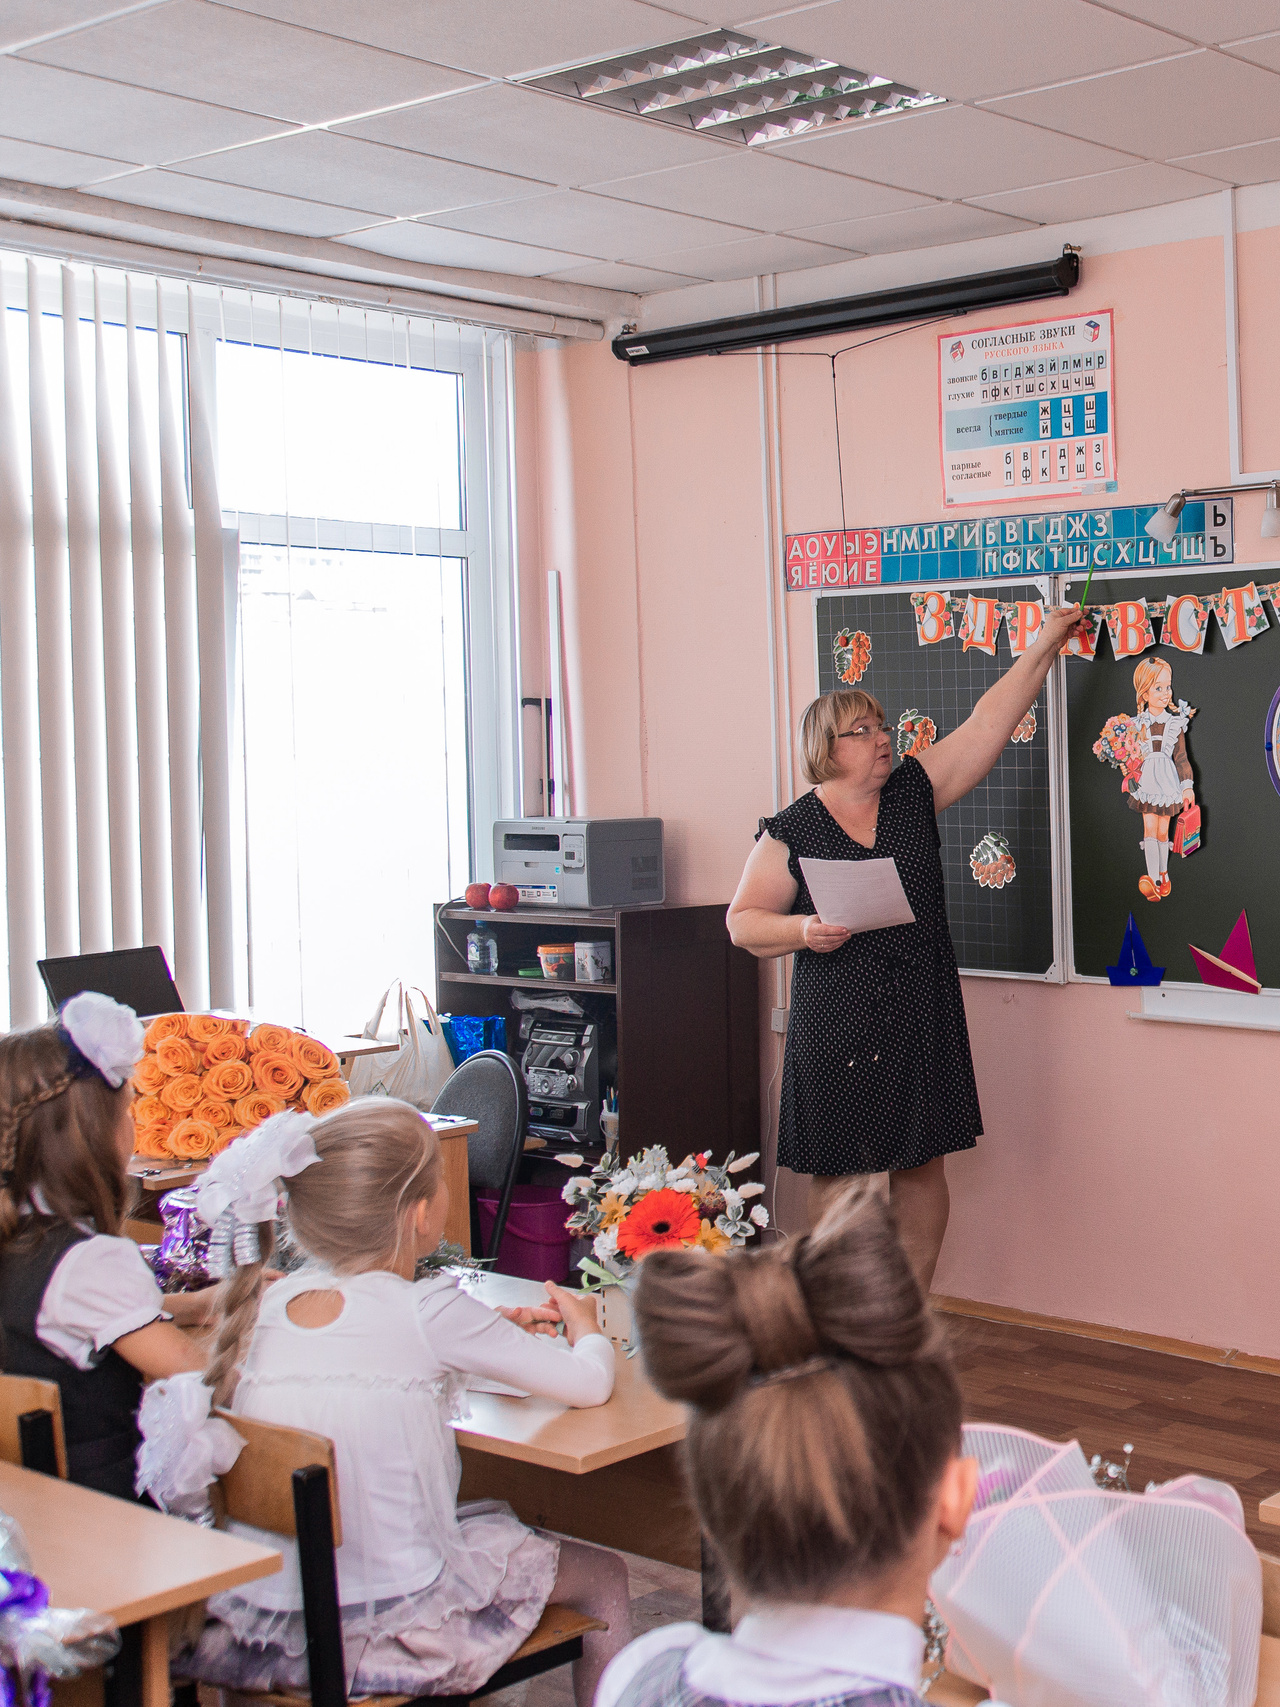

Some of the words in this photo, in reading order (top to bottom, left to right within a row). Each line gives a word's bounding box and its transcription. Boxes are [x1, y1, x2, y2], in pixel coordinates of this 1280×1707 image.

[972, 331, 1036, 350] СОГЛАСНЫЕ
[1040, 325, 1076, 339] ЗВУКИ
[984, 346, 1029, 359] РУССКОГО
[1033, 342, 1064, 353] ЯЗЫКА
[948, 373, 977, 384] звонкие
[948, 391, 974, 401] глухие
[994, 410, 1027, 420] твердые
[956, 424, 981, 434] всегда
[995, 427, 1023, 436] мягкие
[951, 462, 981, 471] парные
[952, 470, 991, 480] согласные
[789, 540, 804, 560] А
[806, 537, 820, 558] О
[823, 536, 837, 556] У
[843, 534, 859, 555] Ы
[864, 533, 878, 554] Э
[883, 532, 897, 552] Н
[902, 530, 918, 551] М
[922, 528, 937, 549] Л
[944, 527, 955, 547] Р
[964, 523, 979, 547] Й
[986, 523, 996, 545] Б
[1006, 521, 1018, 543] В
[1029, 519, 1039, 541] Г
[1047, 518, 1064, 543] Д
[1068, 516, 1088, 538] Ж
[1094, 514, 1107, 537] З
[791, 566, 802, 586] Я
[809, 563, 817, 584] Ё
[822, 563, 839, 583] Ю
[843, 561, 858, 582] И
[866, 561, 877, 581] Е
[985, 551, 996, 572] П
[1002, 550, 1020, 571] Ф
[1027, 550, 1041, 570] К
[1050, 548, 1063, 568] Т
[1068, 545, 1088, 567] Ш
[1093, 544, 1107, 566] С
[1115, 543, 1130, 564] Х
[1138, 541, 1155, 564] Ц
[1162, 541, 1177, 561] Ч
[1183, 537, 1204, 561] Щ
